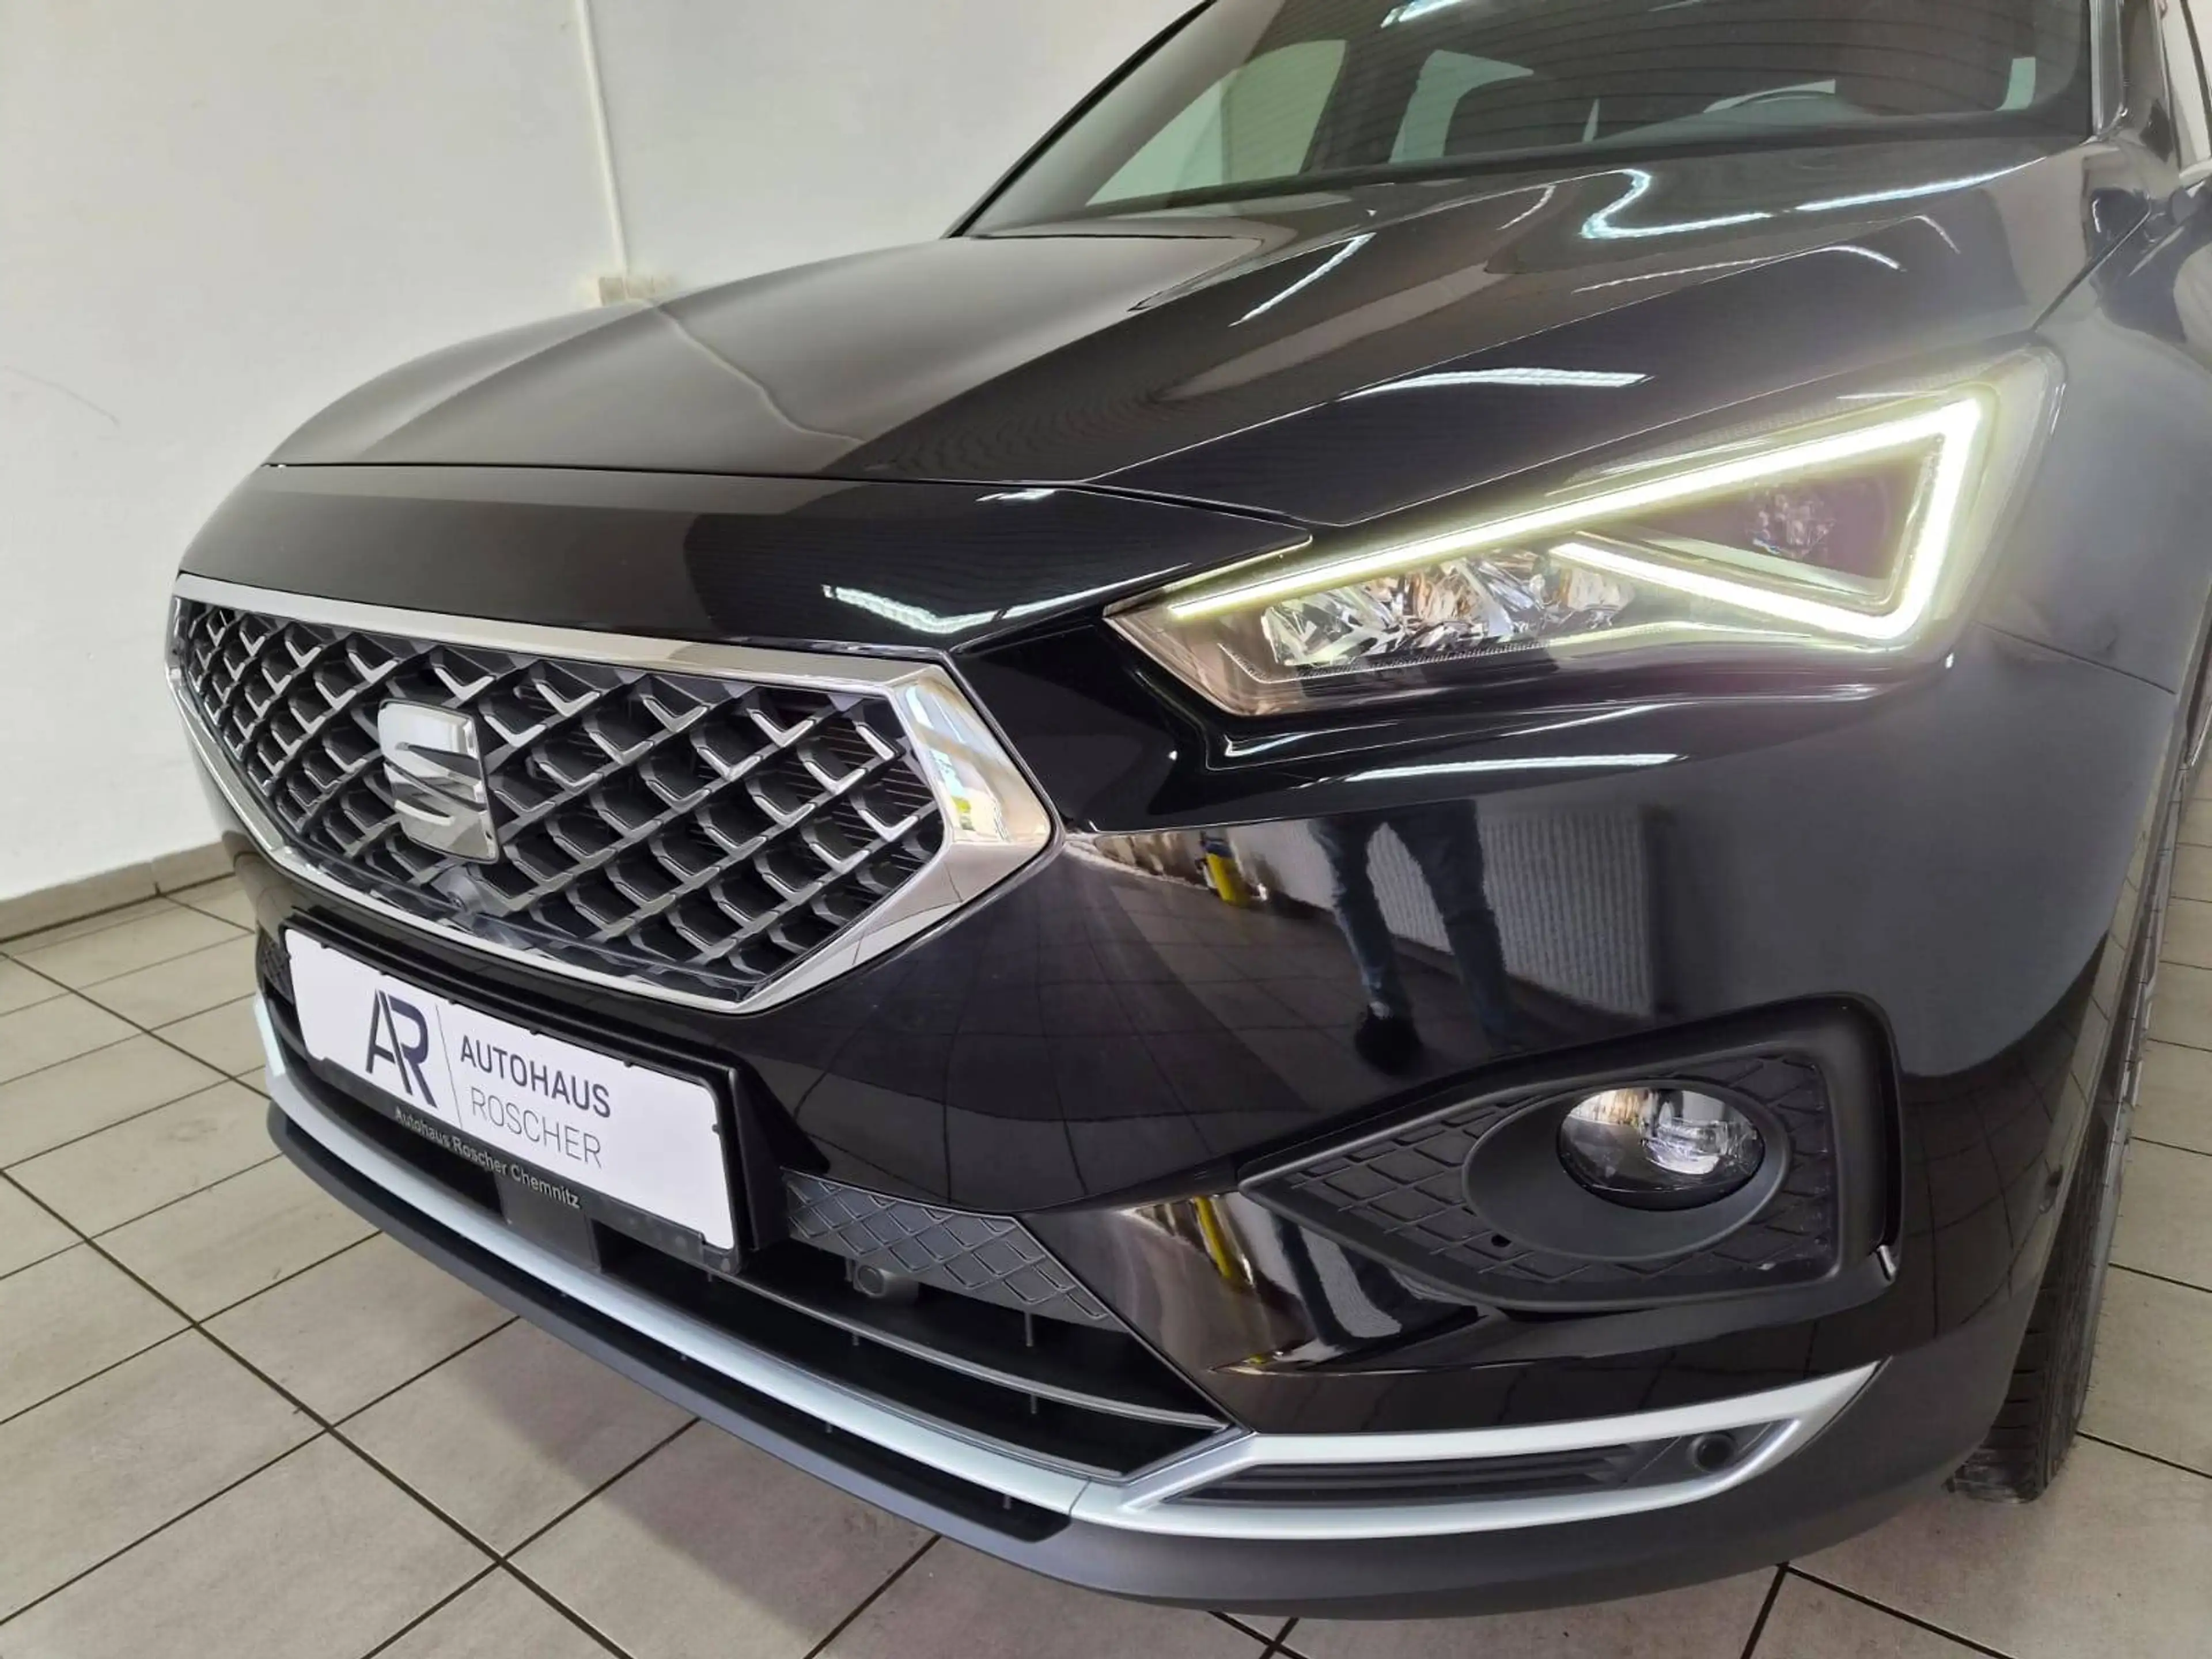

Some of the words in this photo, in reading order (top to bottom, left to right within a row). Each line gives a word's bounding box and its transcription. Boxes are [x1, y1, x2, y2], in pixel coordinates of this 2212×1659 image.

[366, 988, 438, 1108] AR
[461, 1035, 611, 1118] AUTOHAUS
[395, 1106, 450, 1149] Autohaus
[453, 1137, 508, 1175] Roscher
[510, 1164, 580, 1209] Chemnitz
[471, 1086, 602, 1169] ROSCHER
